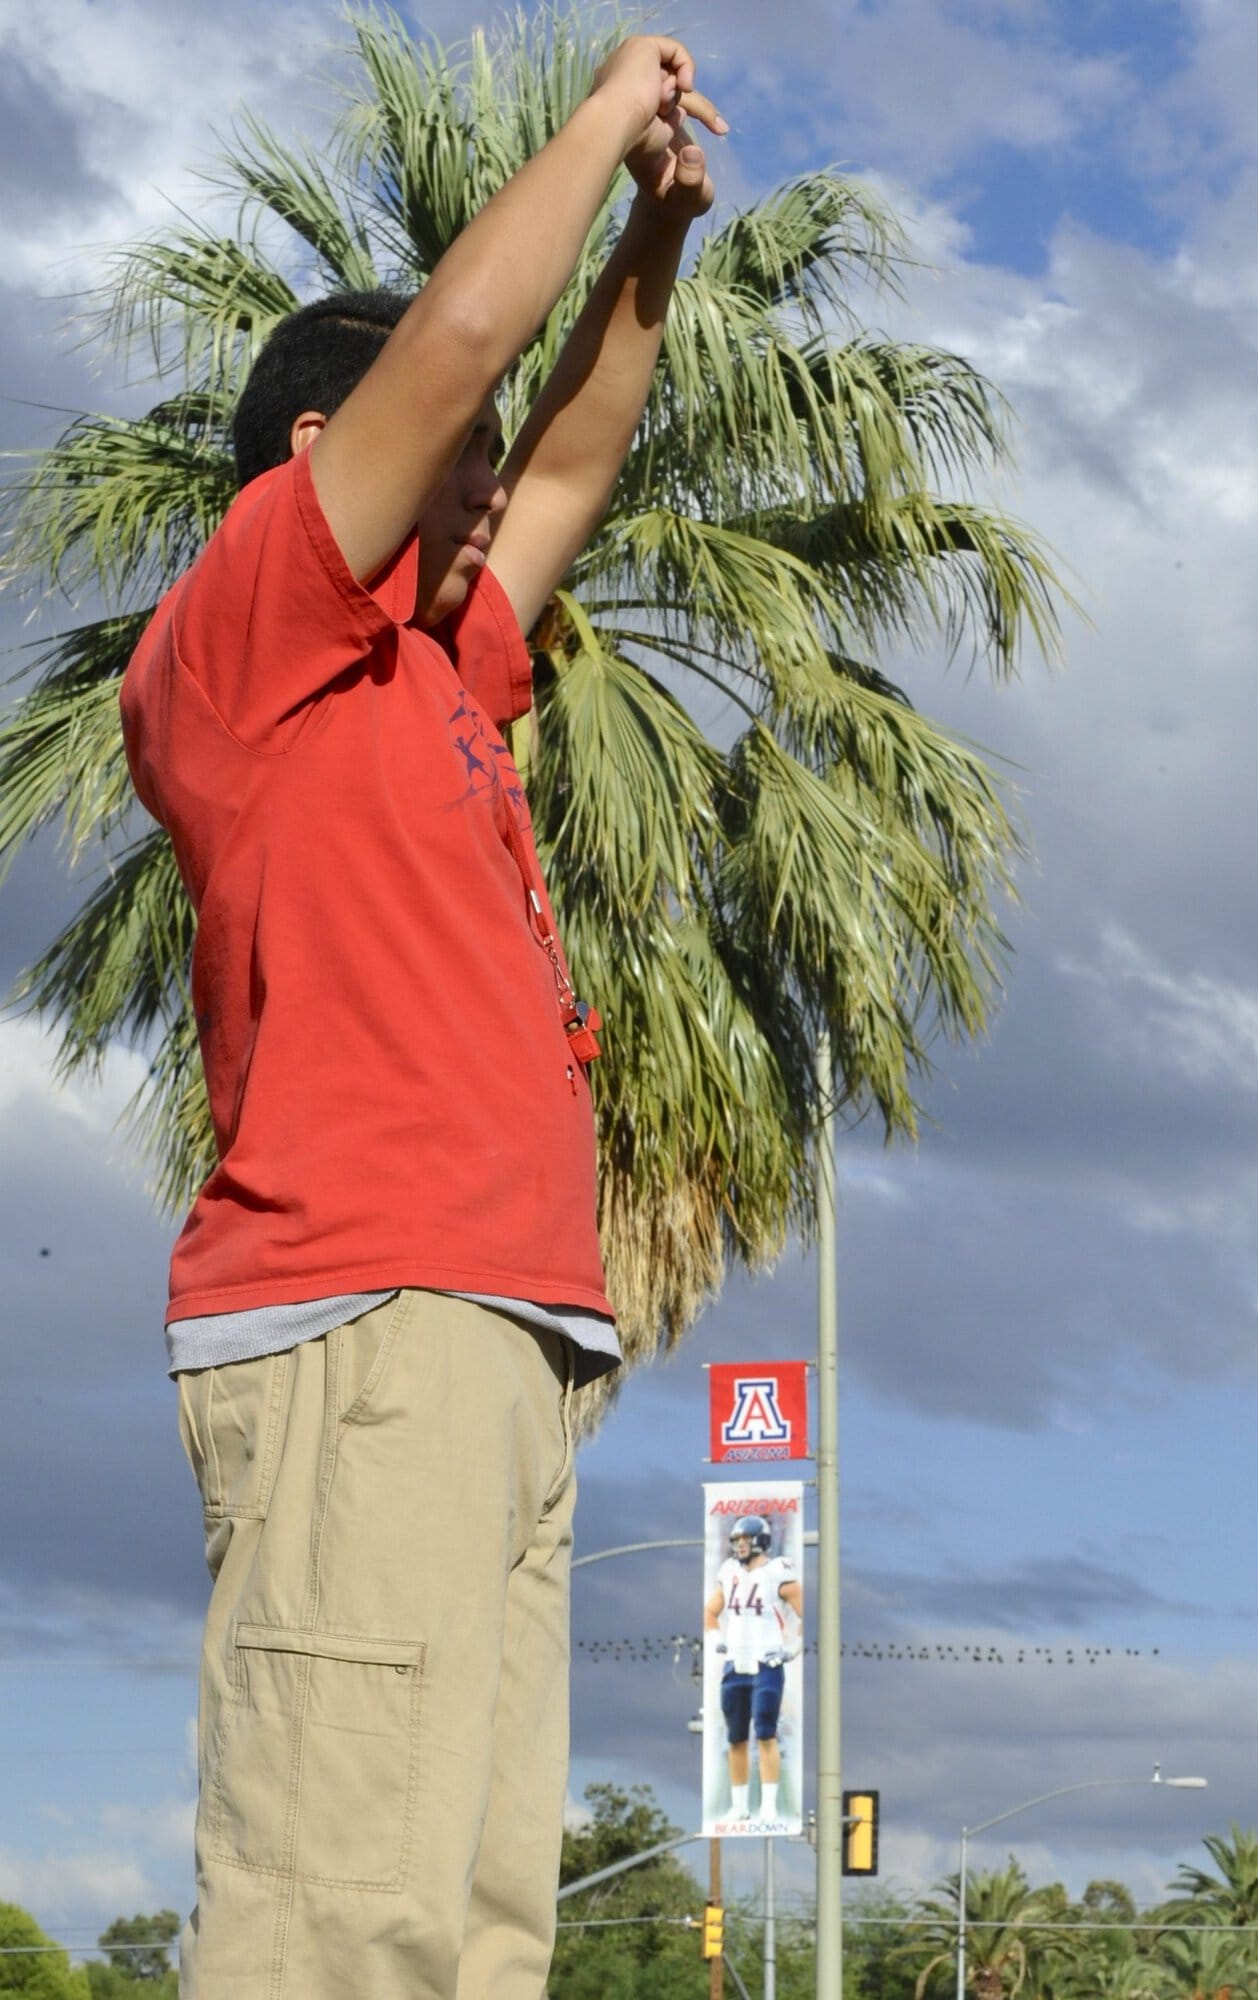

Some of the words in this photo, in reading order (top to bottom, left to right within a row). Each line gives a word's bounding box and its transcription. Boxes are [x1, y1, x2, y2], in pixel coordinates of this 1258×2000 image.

[721, 1378, 791, 1445] A
[710, 1497, 799, 1516] ARIZONA
[728, 1581, 764, 1616] 44
